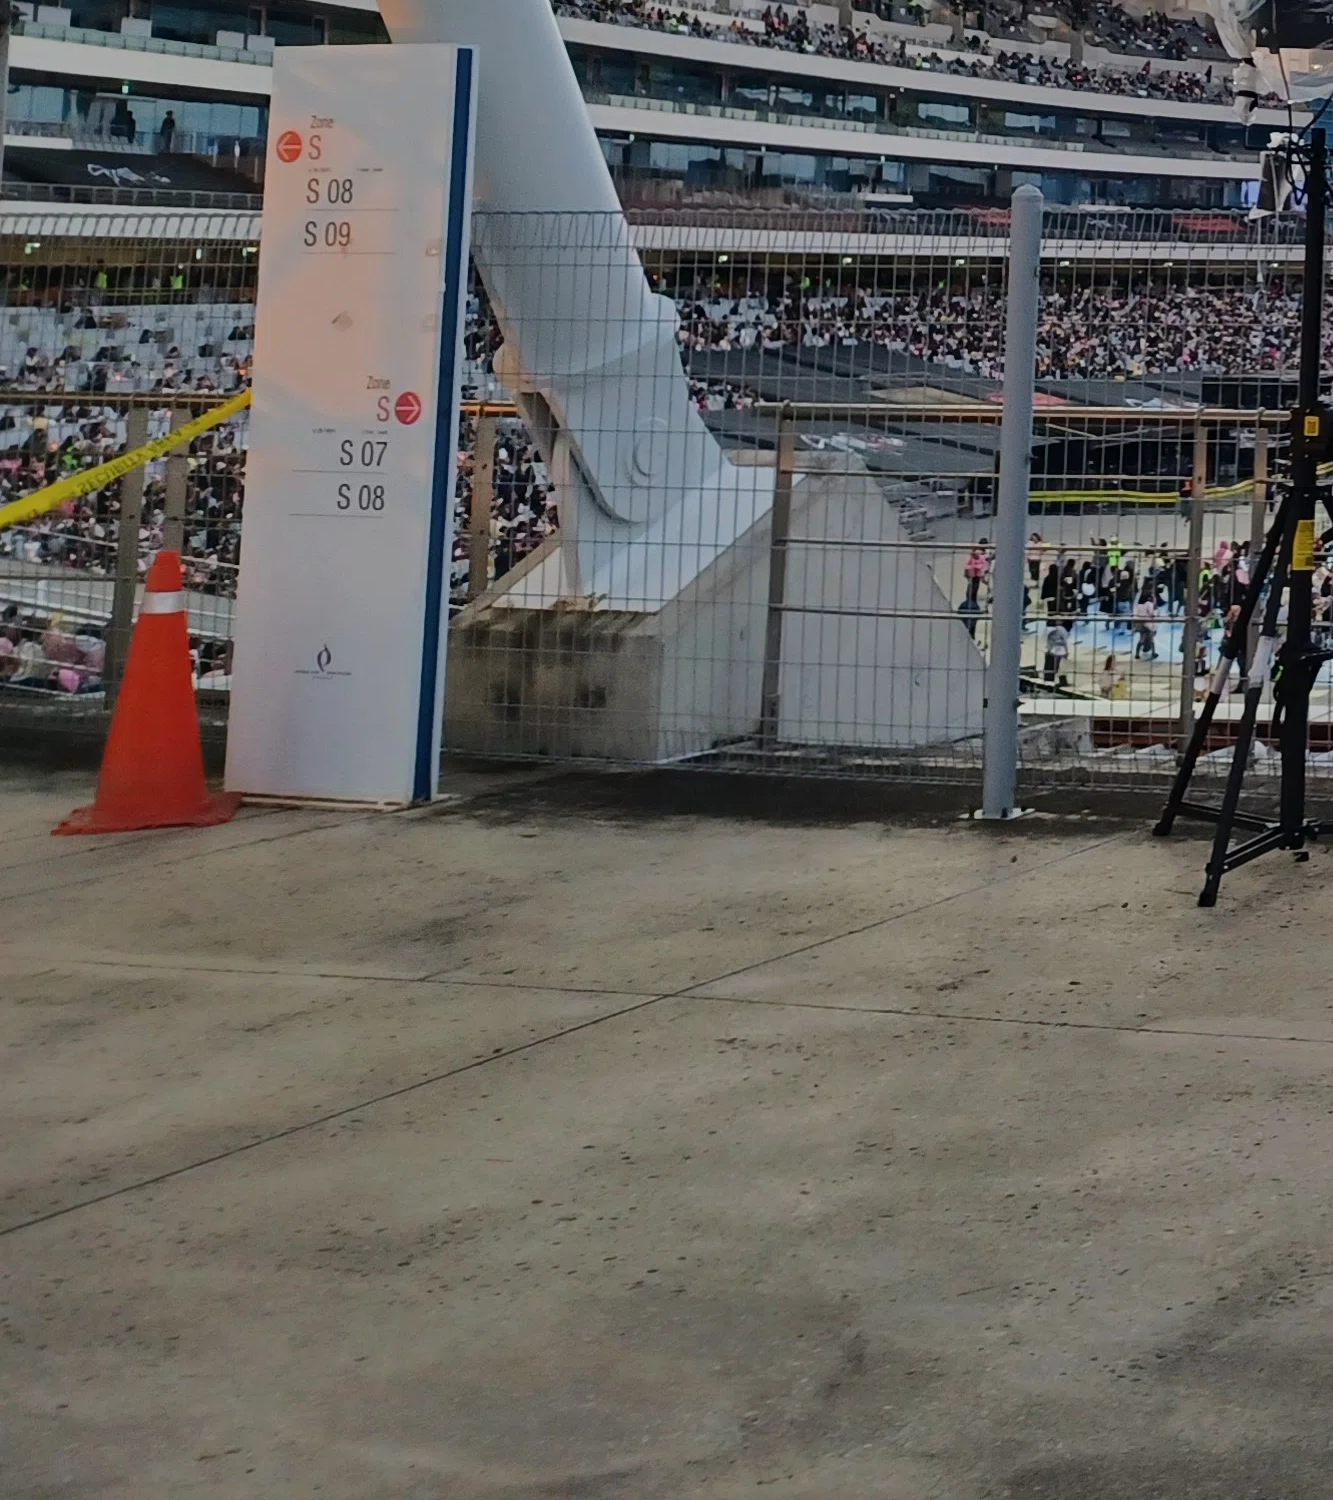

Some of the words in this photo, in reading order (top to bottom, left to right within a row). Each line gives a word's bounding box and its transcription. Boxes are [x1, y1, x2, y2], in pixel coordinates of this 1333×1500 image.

[310, 114, 335, 129] Zone
[308, 134, 322, 160] S
[306, 178, 320, 204] S
[327, 178, 354, 204] 08
[304, 220, 318, 247] S
[325, 221, 352, 247] 09
[366, 375, 392, 390] Zone
[376, 395, 391, 422] S
[340, 439, 354, 466] S
[361, 440, 389, 467] 07
[336, 483, 351, 510] S
[358, 484, 386, 511] 08
